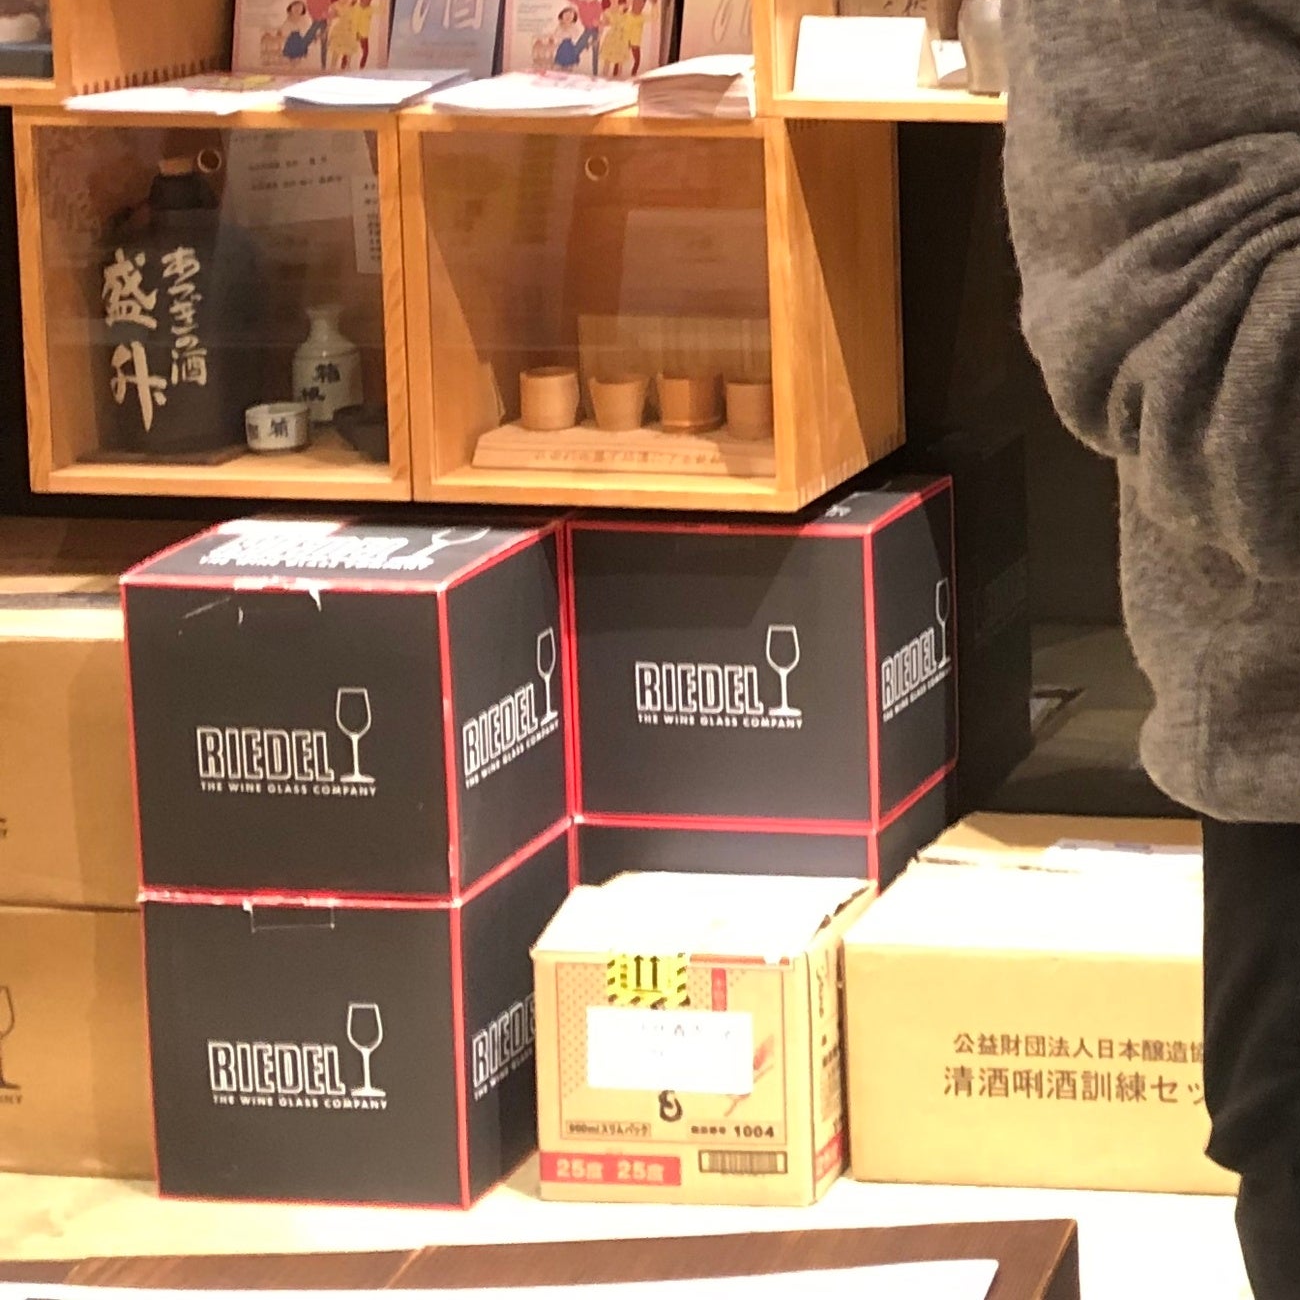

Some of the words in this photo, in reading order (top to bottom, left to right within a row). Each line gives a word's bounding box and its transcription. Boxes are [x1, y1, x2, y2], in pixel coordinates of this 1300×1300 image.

[634, 661, 764, 715] RIEDEL
[881, 627, 937, 712] RIEDEL
[462, 681, 538, 777] RIEDEL
[638, 714, 658, 724] THE
[664, 715, 695, 726] WINE
[701, 716, 738, 727] GLASS
[743, 717, 803, 729] COMPANY
[196, 726, 335, 782] RIEDEL
[201, 781, 222, 792] THE
[229, 783, 262, 793] WINE
[267, 784, 308, 795] GLASS
[313, 785, 377, 797] COMPANY
[472, 992, 535, 1088] RIEDE
[207, 1040, 346, 1095] RIEDEL
[213, 1095, 235, 1105] THE
[240, 1096, 274, 1107] WINE
[279, 1097, 319, 1108] GLASS
[324, 1098, 387, 1110] COMPANY
[734, 1125, 775, 1138] 1004
